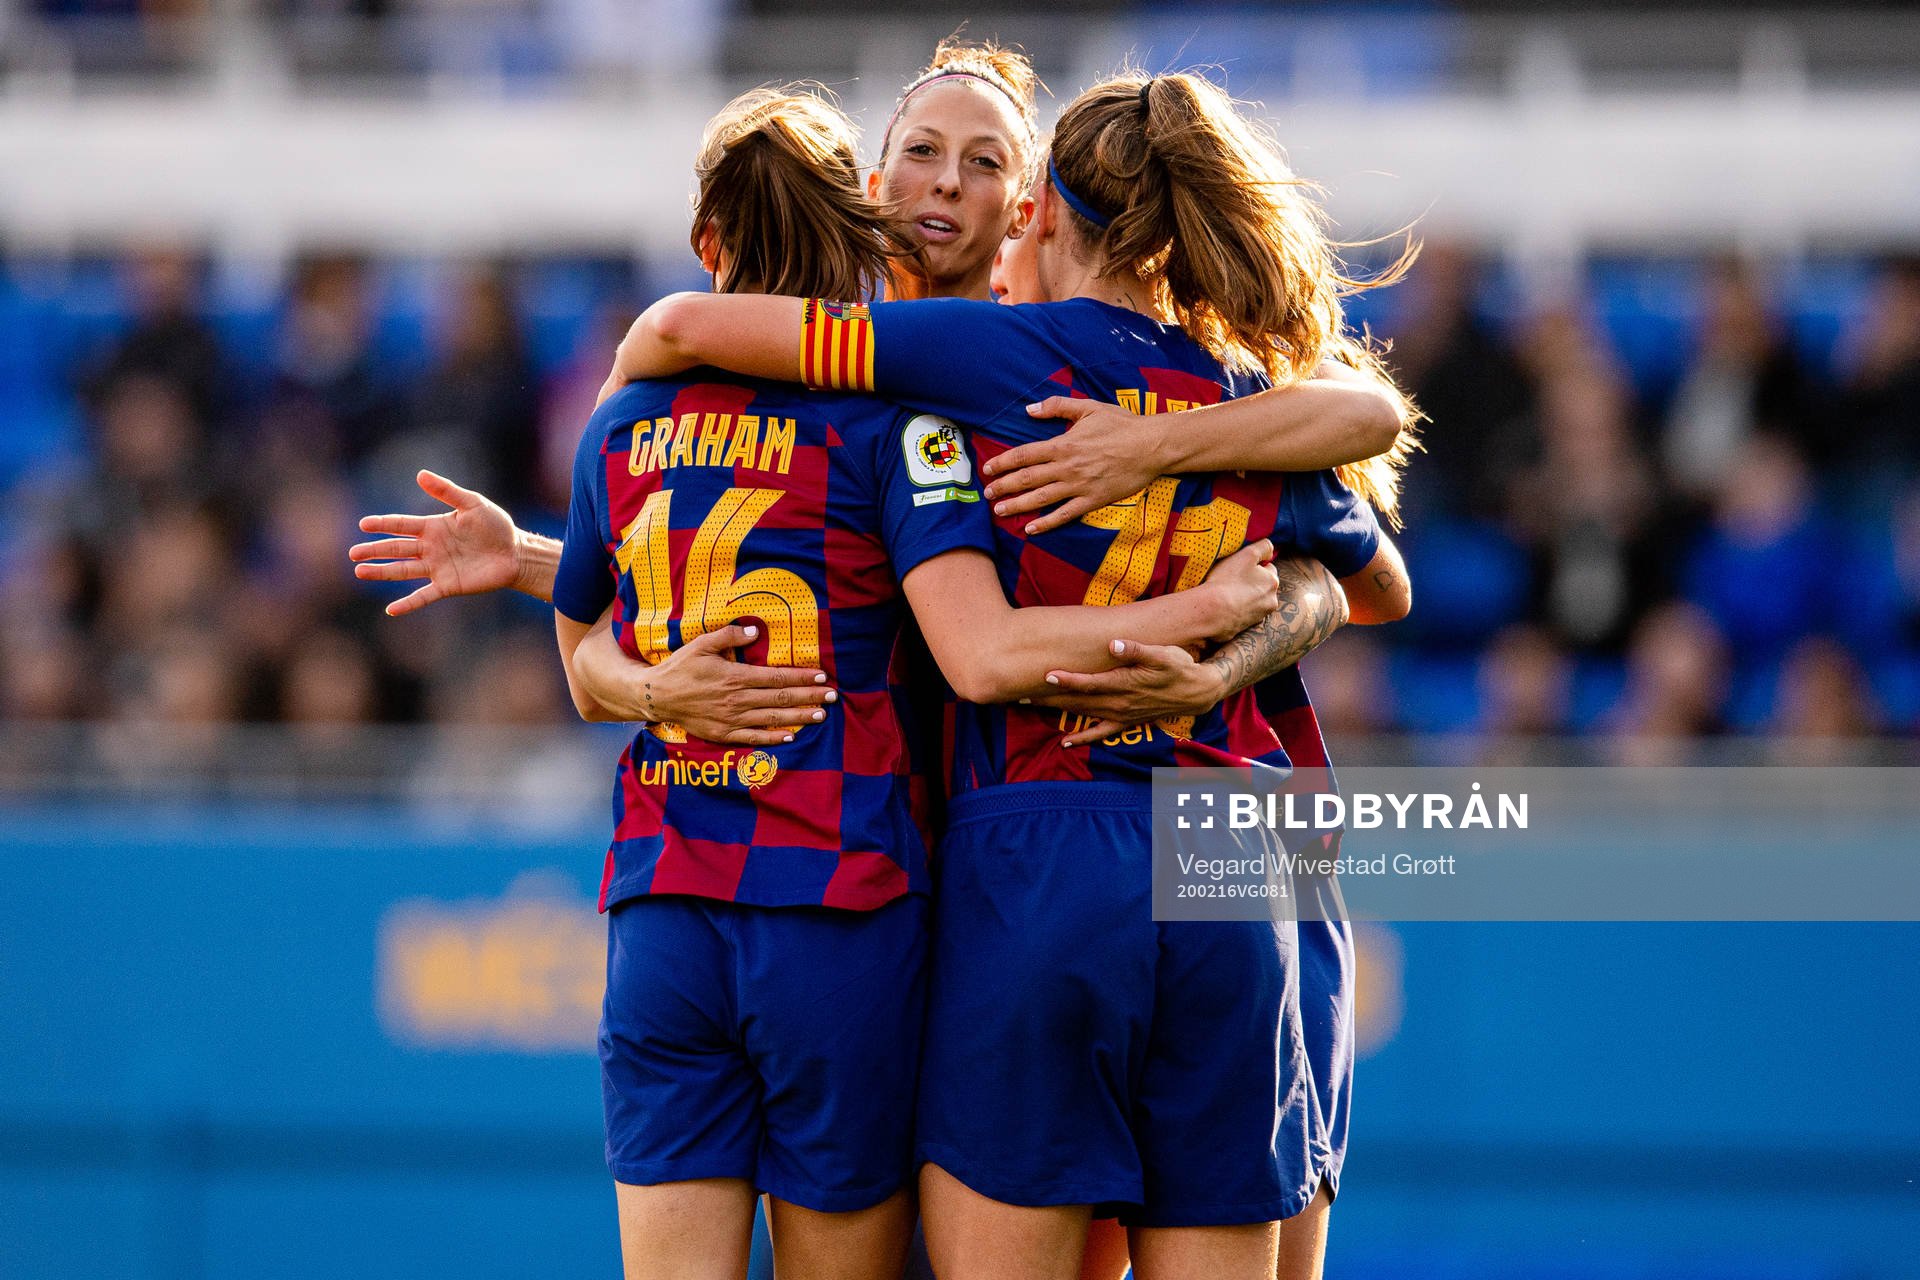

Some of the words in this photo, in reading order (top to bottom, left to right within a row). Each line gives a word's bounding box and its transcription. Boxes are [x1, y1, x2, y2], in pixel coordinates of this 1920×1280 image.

[628, 412, 796, 477] GRAHAM
[614, 487, 820, 743] 16
[1059, 711, 1153, 747] unce
[640, 751, 735, 787] unicef
